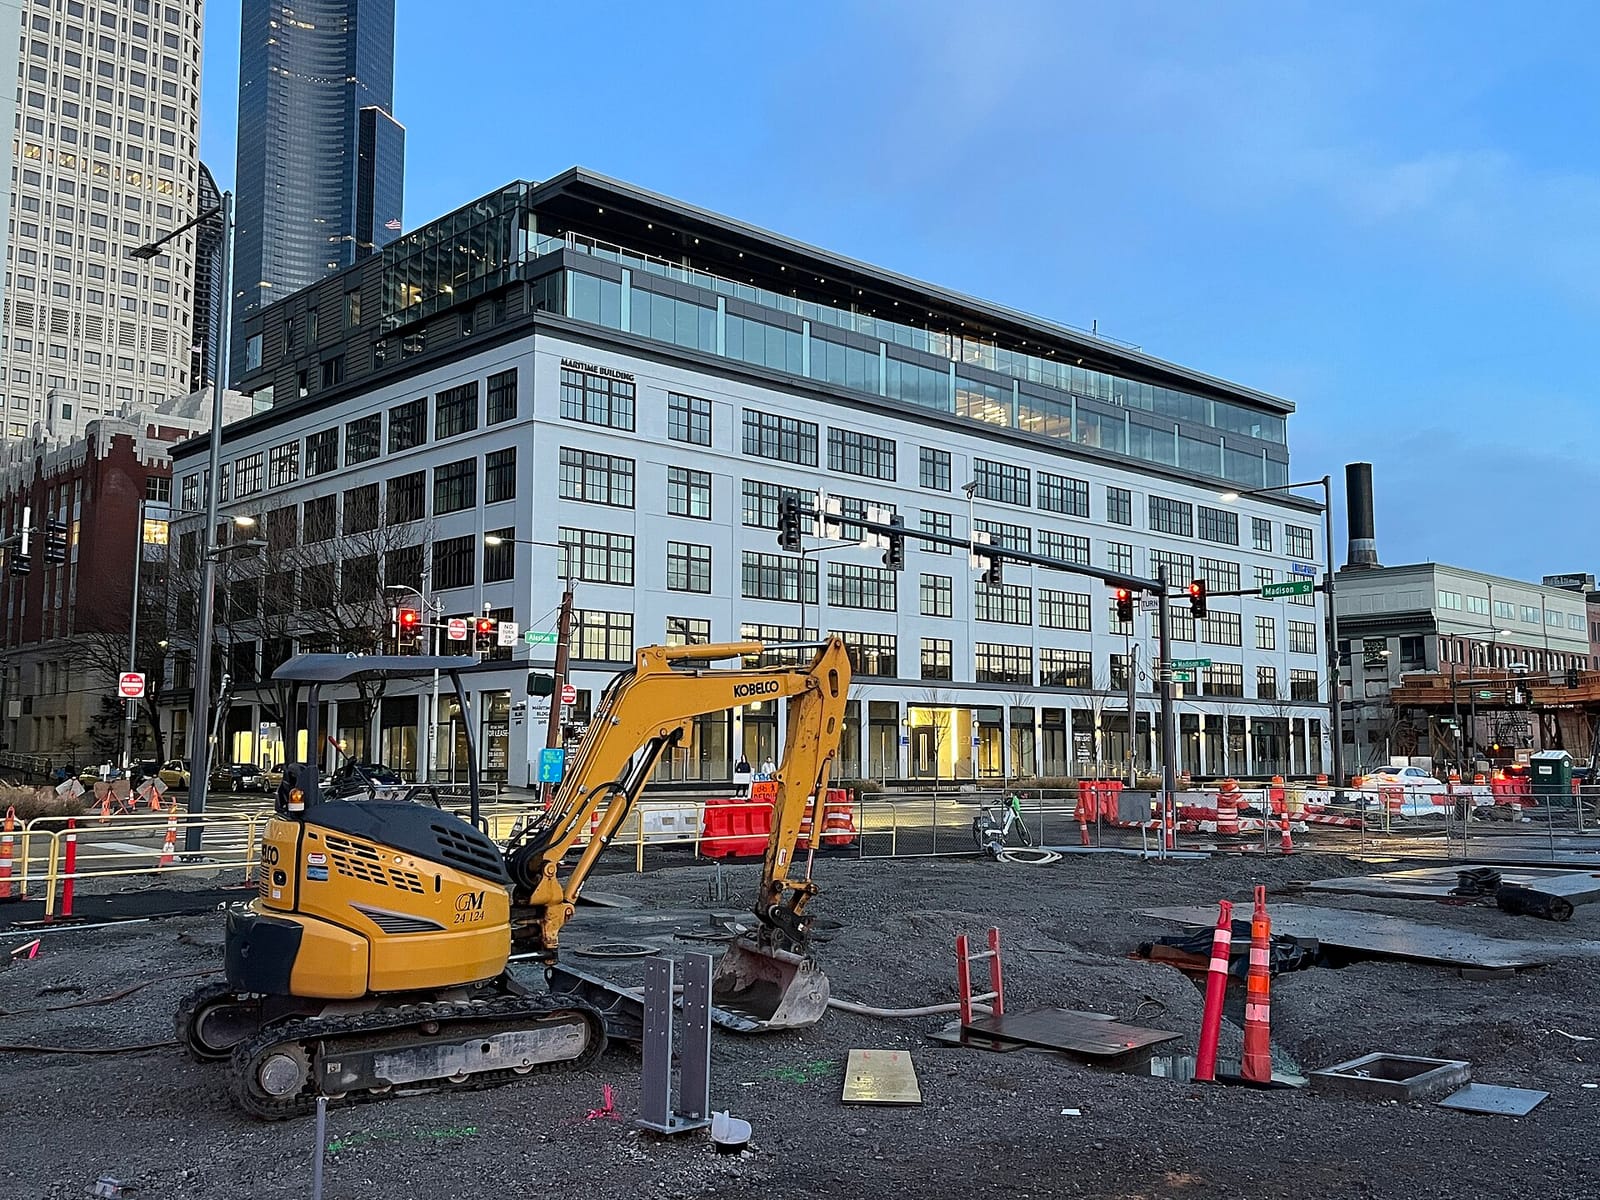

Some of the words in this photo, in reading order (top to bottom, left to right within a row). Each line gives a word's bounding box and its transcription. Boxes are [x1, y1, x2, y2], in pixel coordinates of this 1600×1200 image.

[560, 358, 598, 374] MARITIME
[599, 367, 635, 381] BUILDING
[1264, 586, 1295, 596] Madison
[1302, 584, 1310, 592] St
[733, 680, 779, 698] KOBELCO
[454, 891, 485, 912] GM
[453, 911, 466, 924] 24
[469, 910, 485, 922] 124
